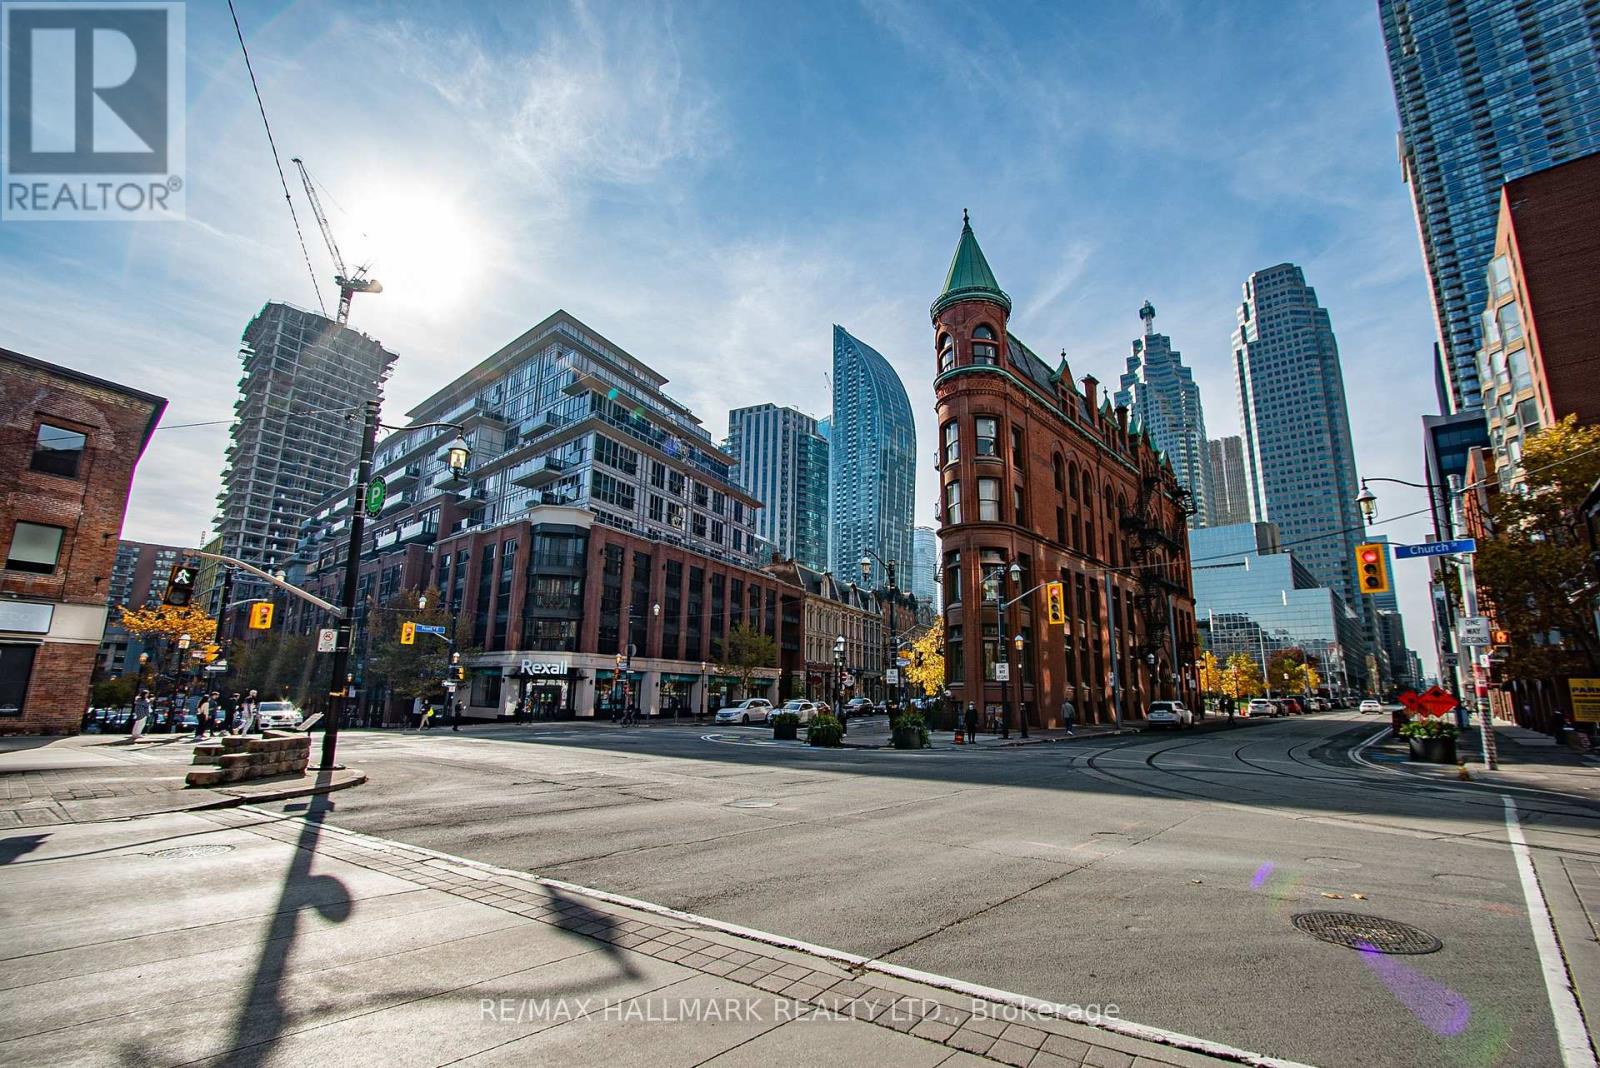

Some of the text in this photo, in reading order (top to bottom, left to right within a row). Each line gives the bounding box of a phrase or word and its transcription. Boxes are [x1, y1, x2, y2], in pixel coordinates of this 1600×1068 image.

[371, 487, 380, 504] P
[1409, 544, 1449, 555] Church
[1461, 636, 1488, 644] BEGINS
[520, 659, 568, 676] Rexall
